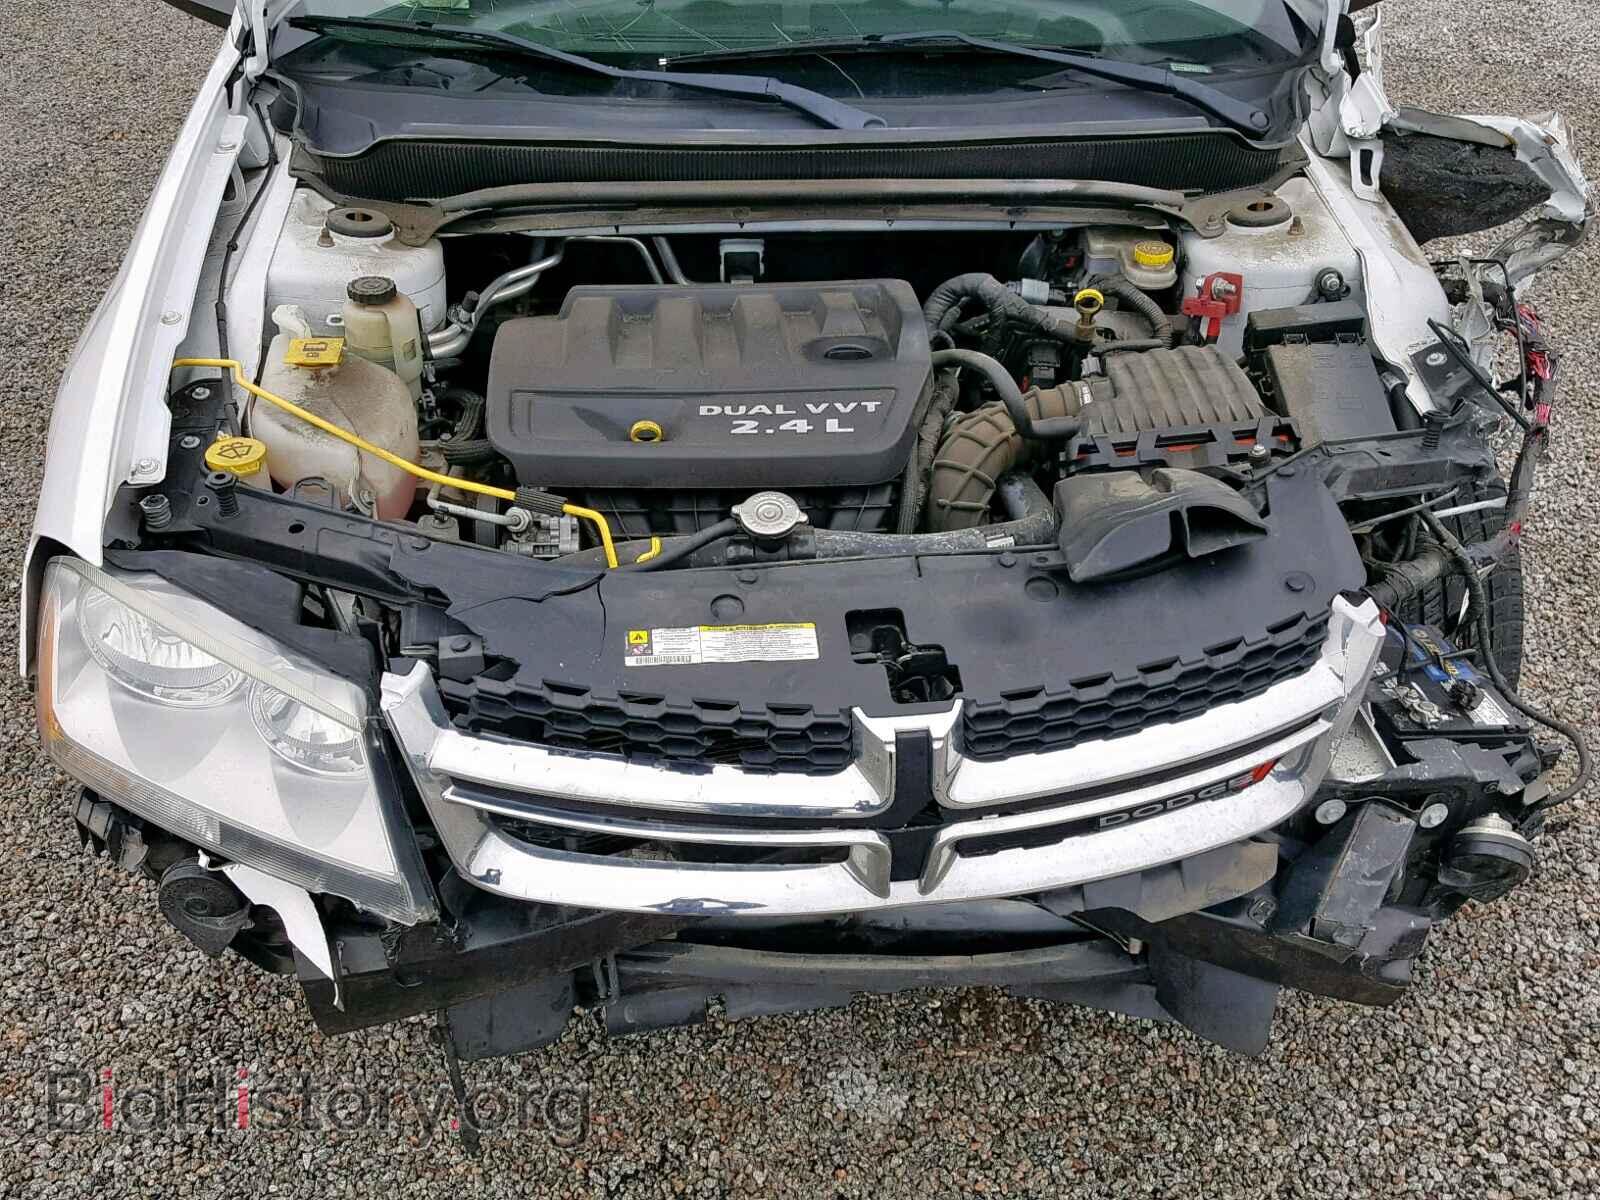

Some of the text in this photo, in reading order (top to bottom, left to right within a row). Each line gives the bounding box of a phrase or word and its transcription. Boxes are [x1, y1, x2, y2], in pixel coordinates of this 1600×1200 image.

[699, 401, 882, 416] DUAL VVT
[1099, 772, 1254, 828] DODGE
